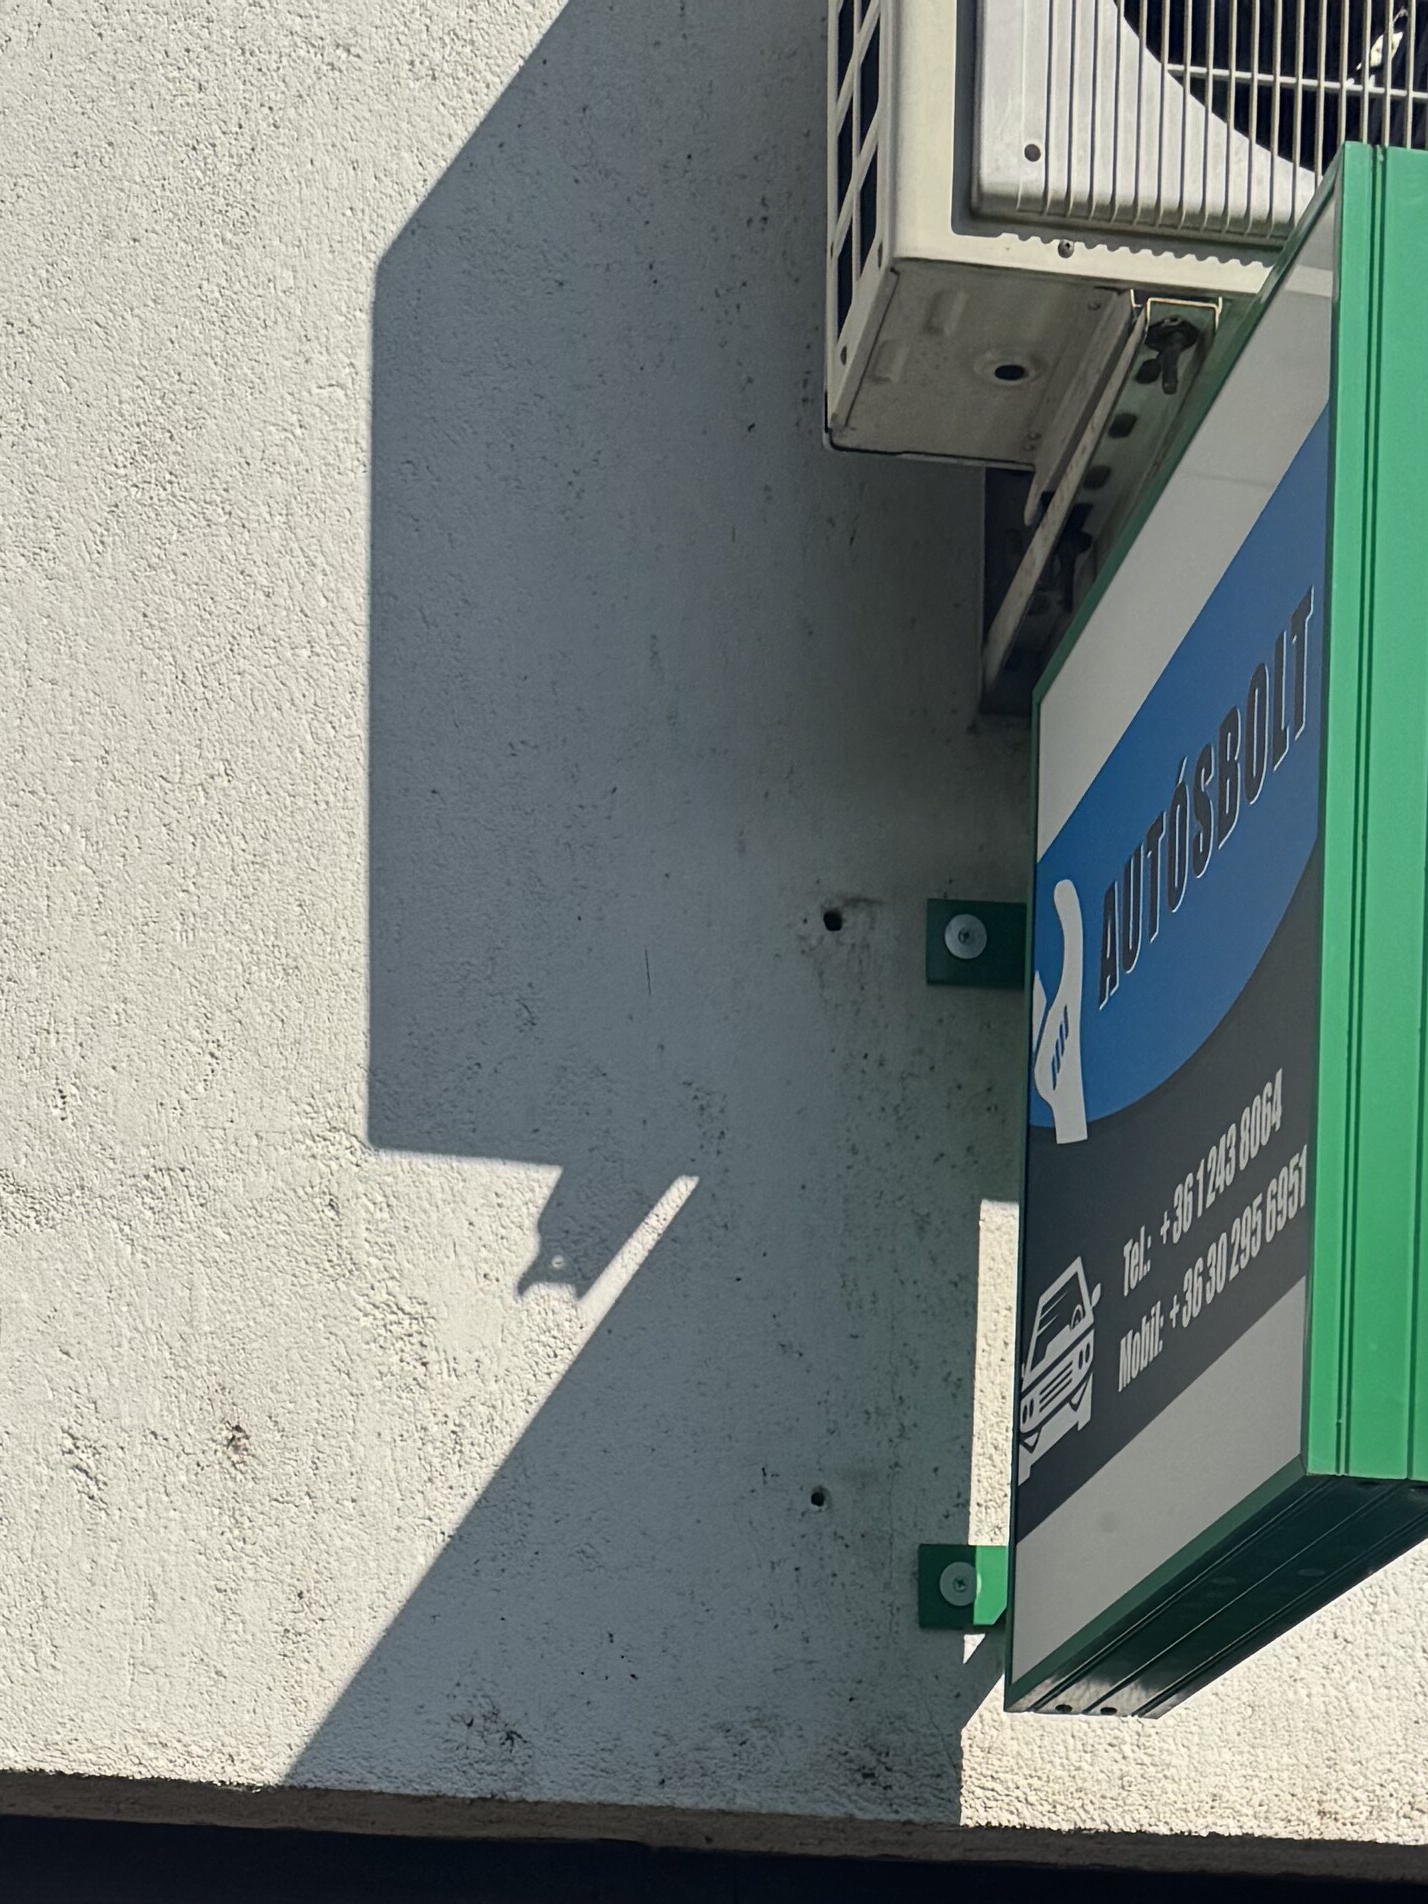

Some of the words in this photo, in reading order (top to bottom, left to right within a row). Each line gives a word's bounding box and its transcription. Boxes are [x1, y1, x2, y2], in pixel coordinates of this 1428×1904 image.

[1099, 586, 1314, 1011] AUTÓSBOLT
[1118, 1300, 1164, 1393] Mobil:
[1170, 1257, 1203, 1329] +36
[1206, 1232, 1226, 1304] 30
[1230, 1192, 1263, 1281] 295
[1266, 1144, 1308, 1243] 6951
[1123, 1225, 1151, 1297] Tel.:
[1160, 1172, 1193, 1245] +36
[1205, 1124, 1236, 1209] 243
[1240, 1067, 1283, 1171] 8064
